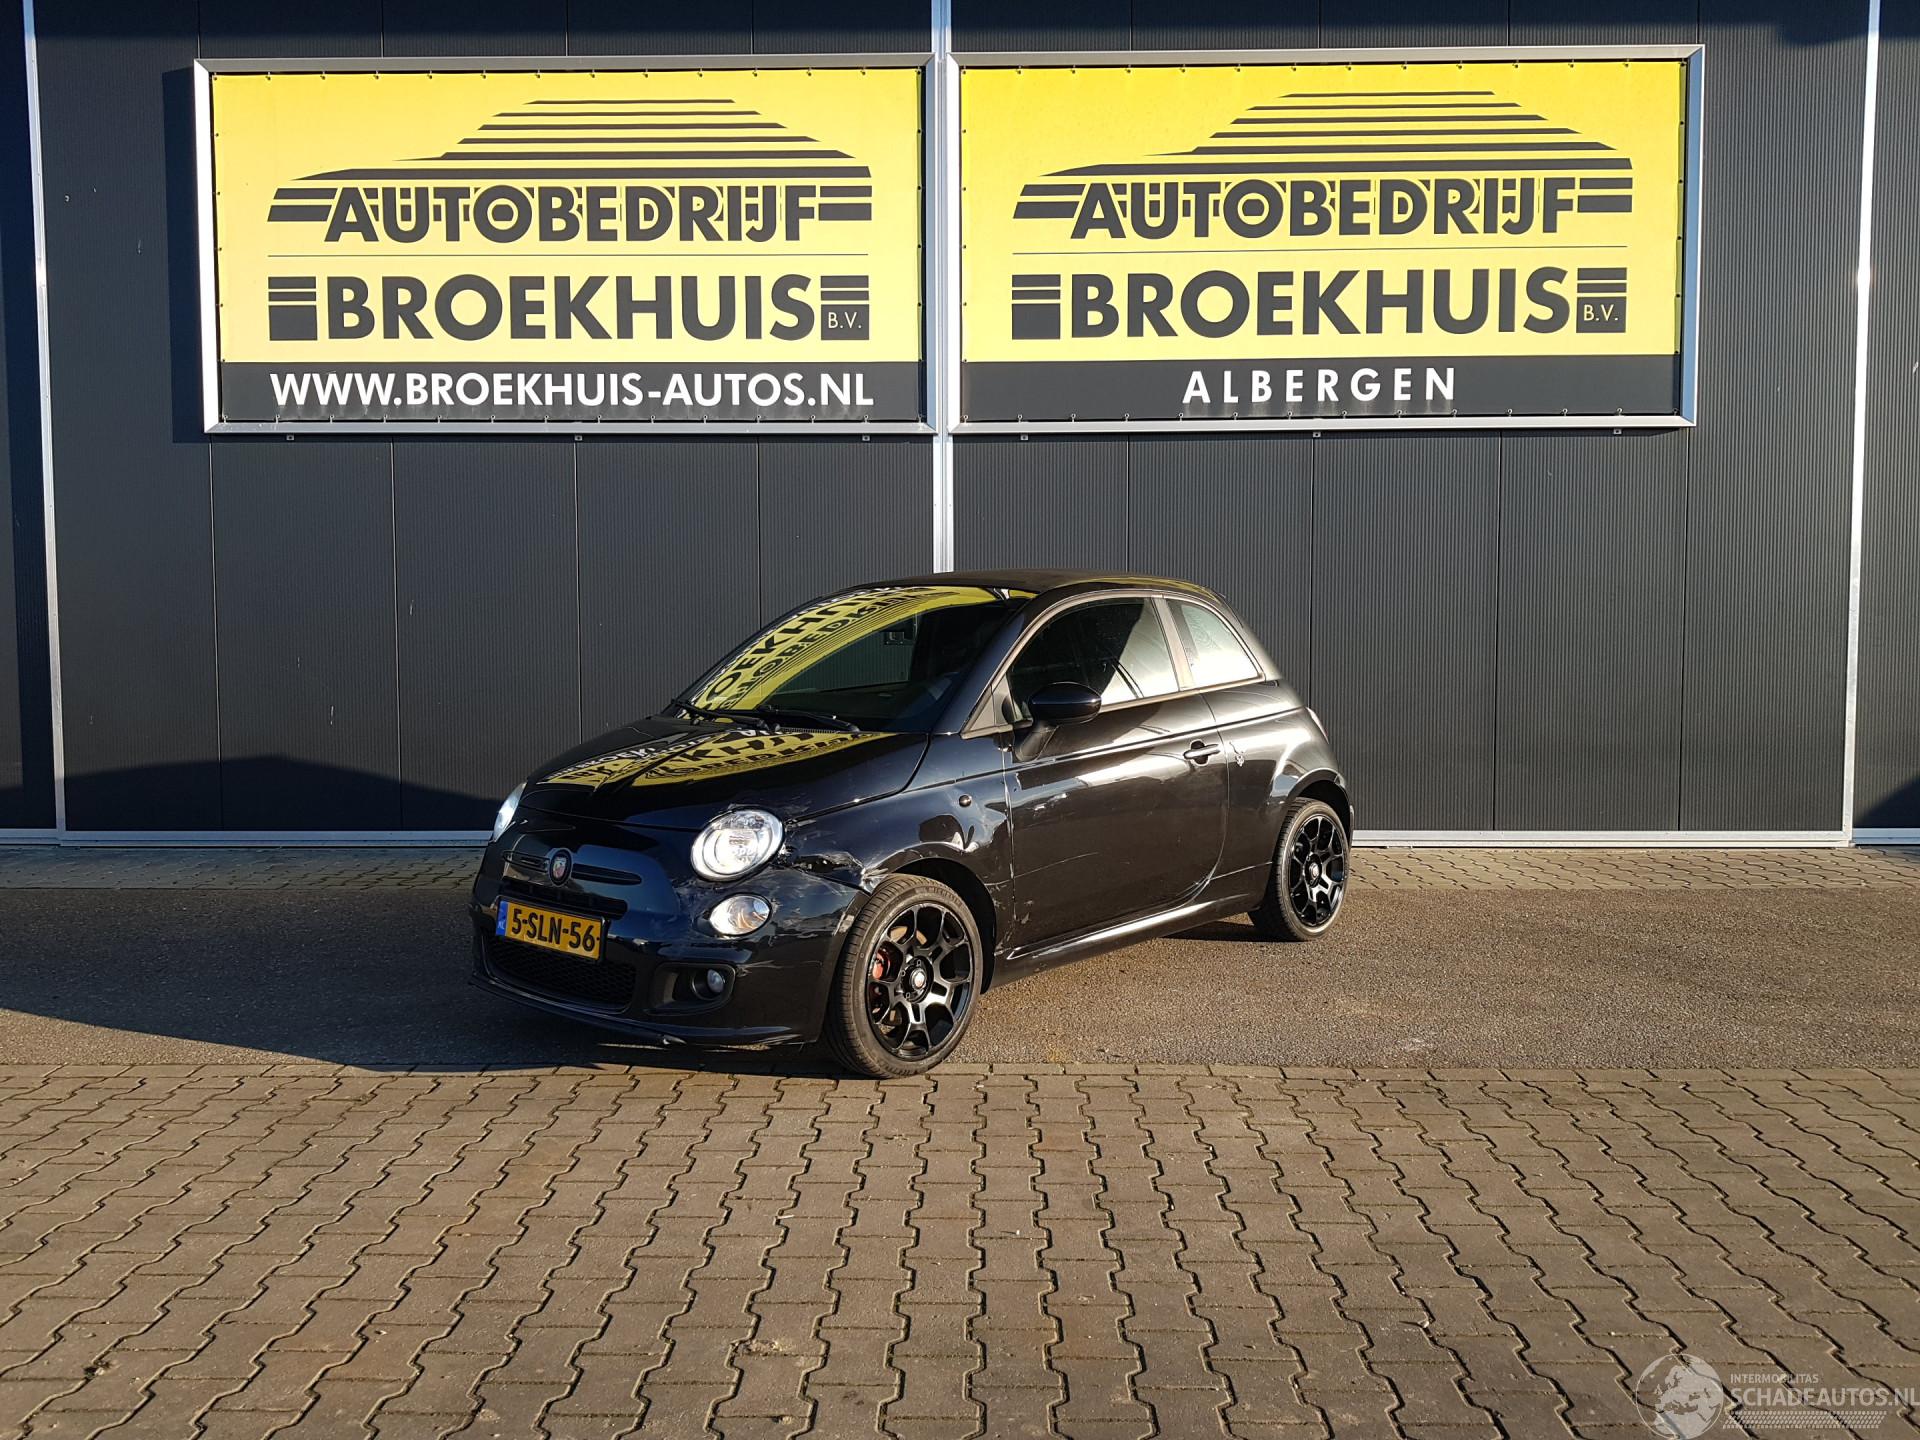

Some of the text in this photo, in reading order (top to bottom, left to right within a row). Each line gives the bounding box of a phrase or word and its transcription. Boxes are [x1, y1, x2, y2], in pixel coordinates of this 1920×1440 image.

[324, 185, 817, 243] AUTOBEDRIJF
[1070, 177, 1577, 239] AUTOBEDRIJF
[327, 273, 861, 341] BROEKHUIS B.V.
[1072, 267, 1619, 338] BROEKHUIS B.V.
[269, 371, 874, 407] WWW.BROEKHUIS-AUTOS.NL
[1183, 367, 1456, 404] ALBERGEN
[511, 908, 595, 952] 5-SLN-56
